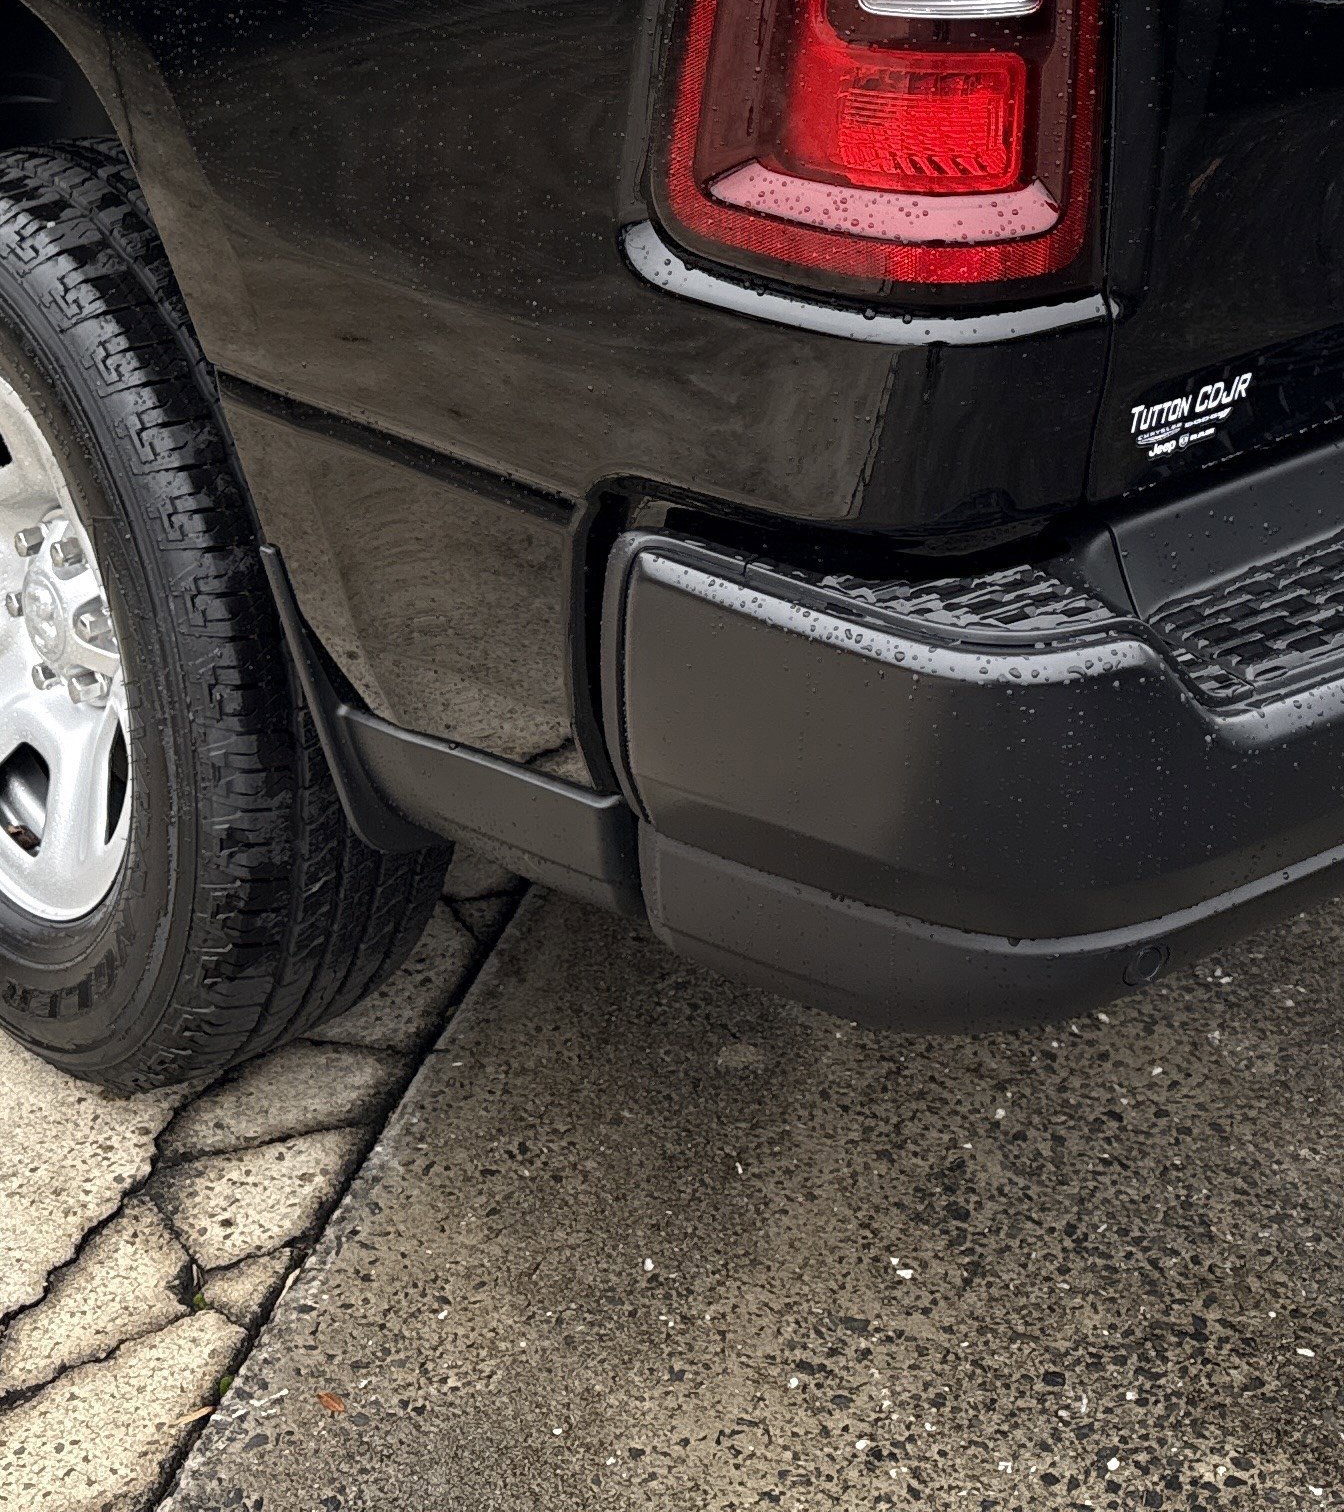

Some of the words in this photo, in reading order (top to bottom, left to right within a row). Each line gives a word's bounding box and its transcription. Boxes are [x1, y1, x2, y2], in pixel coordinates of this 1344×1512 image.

[1130, 395, 1193, 434] TUTTON
[1195, 372, 1253, 413] CDJR
[1148, 440, 1177, 457] Jeep
